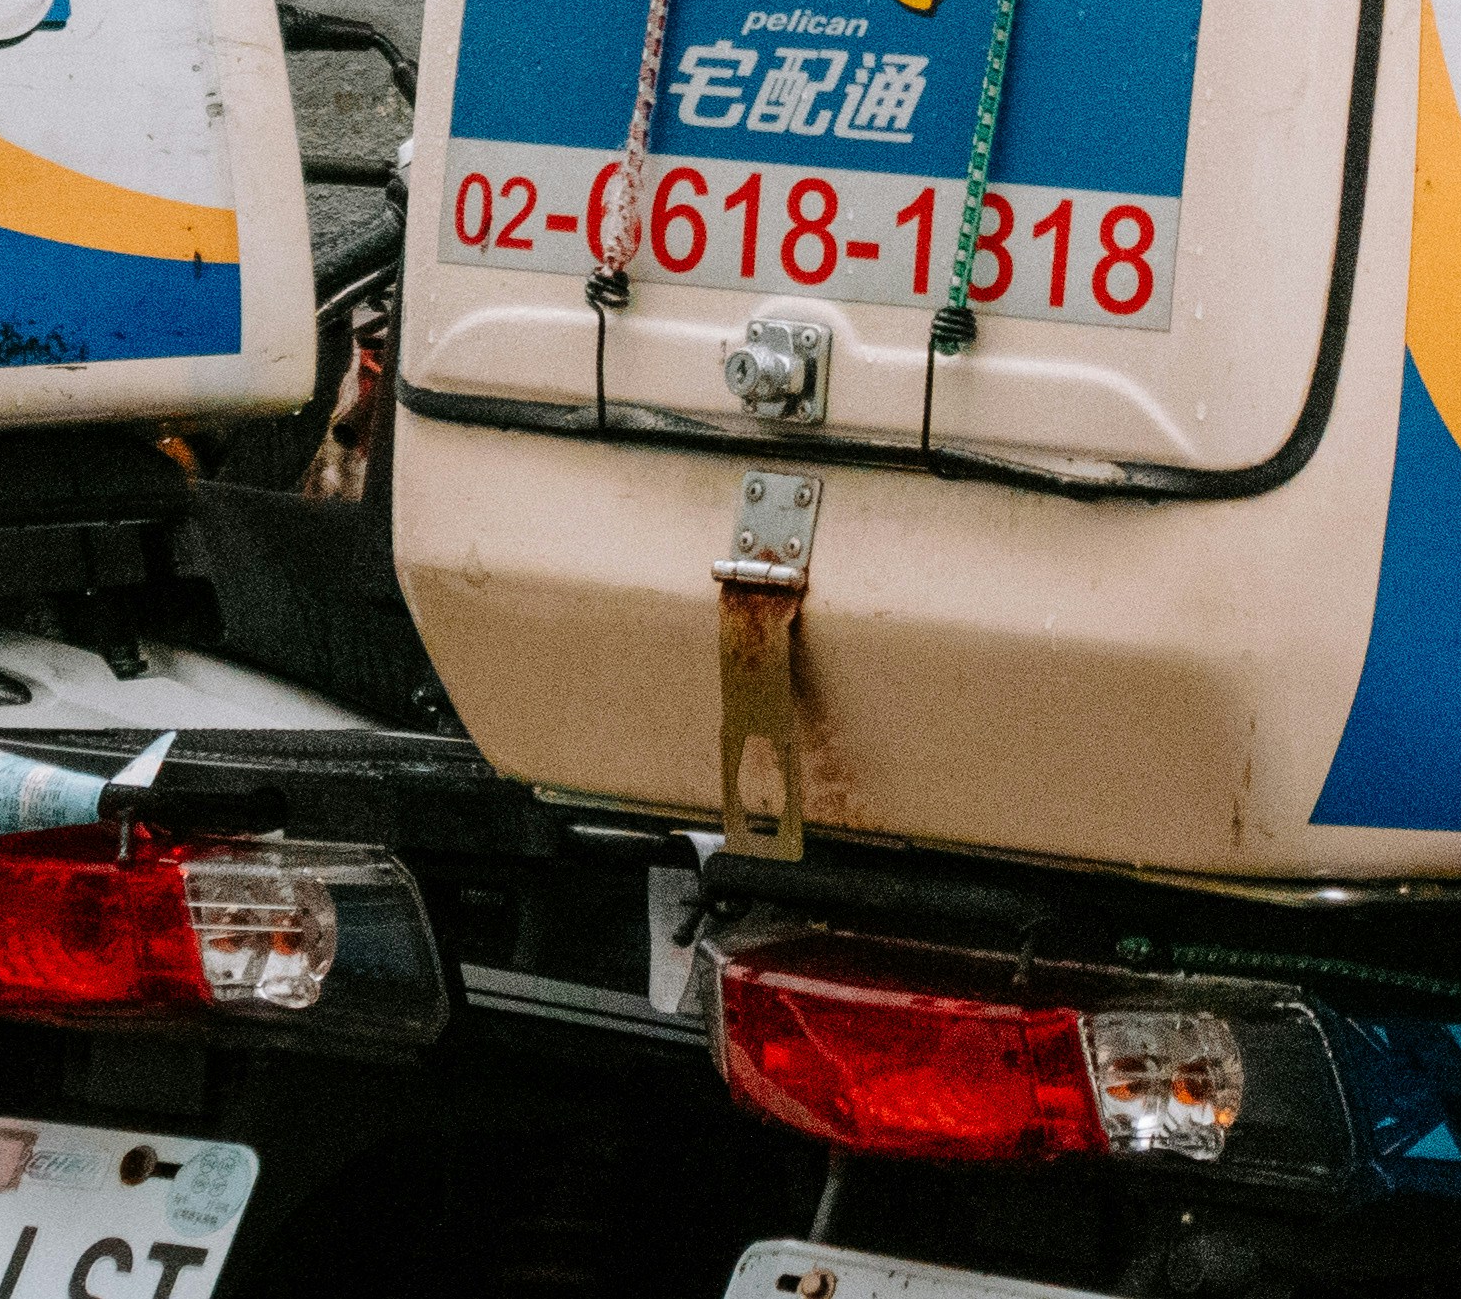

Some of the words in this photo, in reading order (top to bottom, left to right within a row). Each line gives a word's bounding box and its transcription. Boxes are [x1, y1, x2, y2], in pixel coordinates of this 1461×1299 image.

[741, 8, 869, 38] pelican
[668, 39, 930, 143] 宅配通
